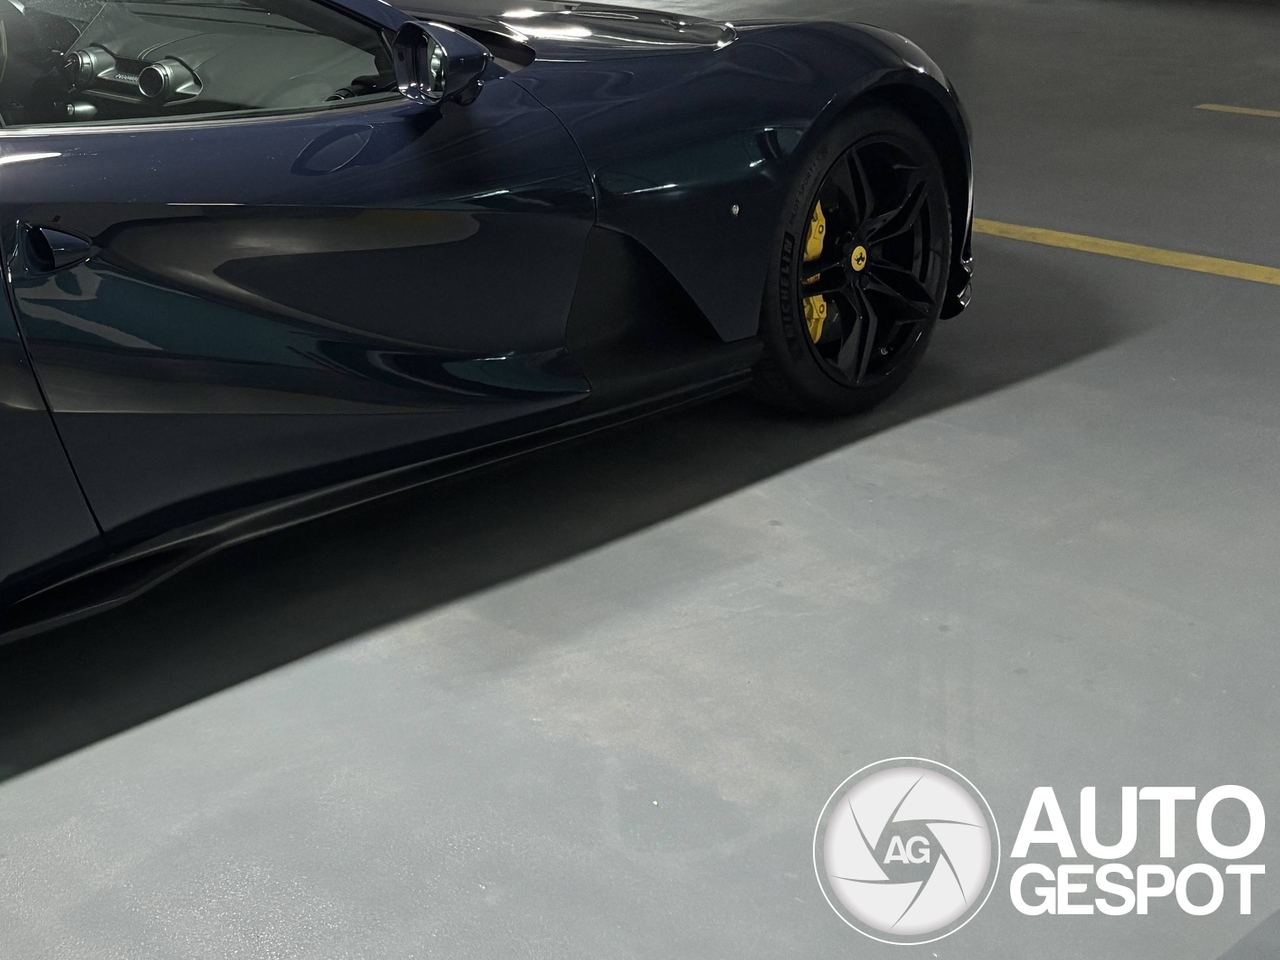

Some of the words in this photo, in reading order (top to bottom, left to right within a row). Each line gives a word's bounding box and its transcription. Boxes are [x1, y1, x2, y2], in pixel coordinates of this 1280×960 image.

[789, 199, 800, 226] PILOT
[799, 167, 814, 196] SPORT
[781, 238, 794, 338] MICHELIN
